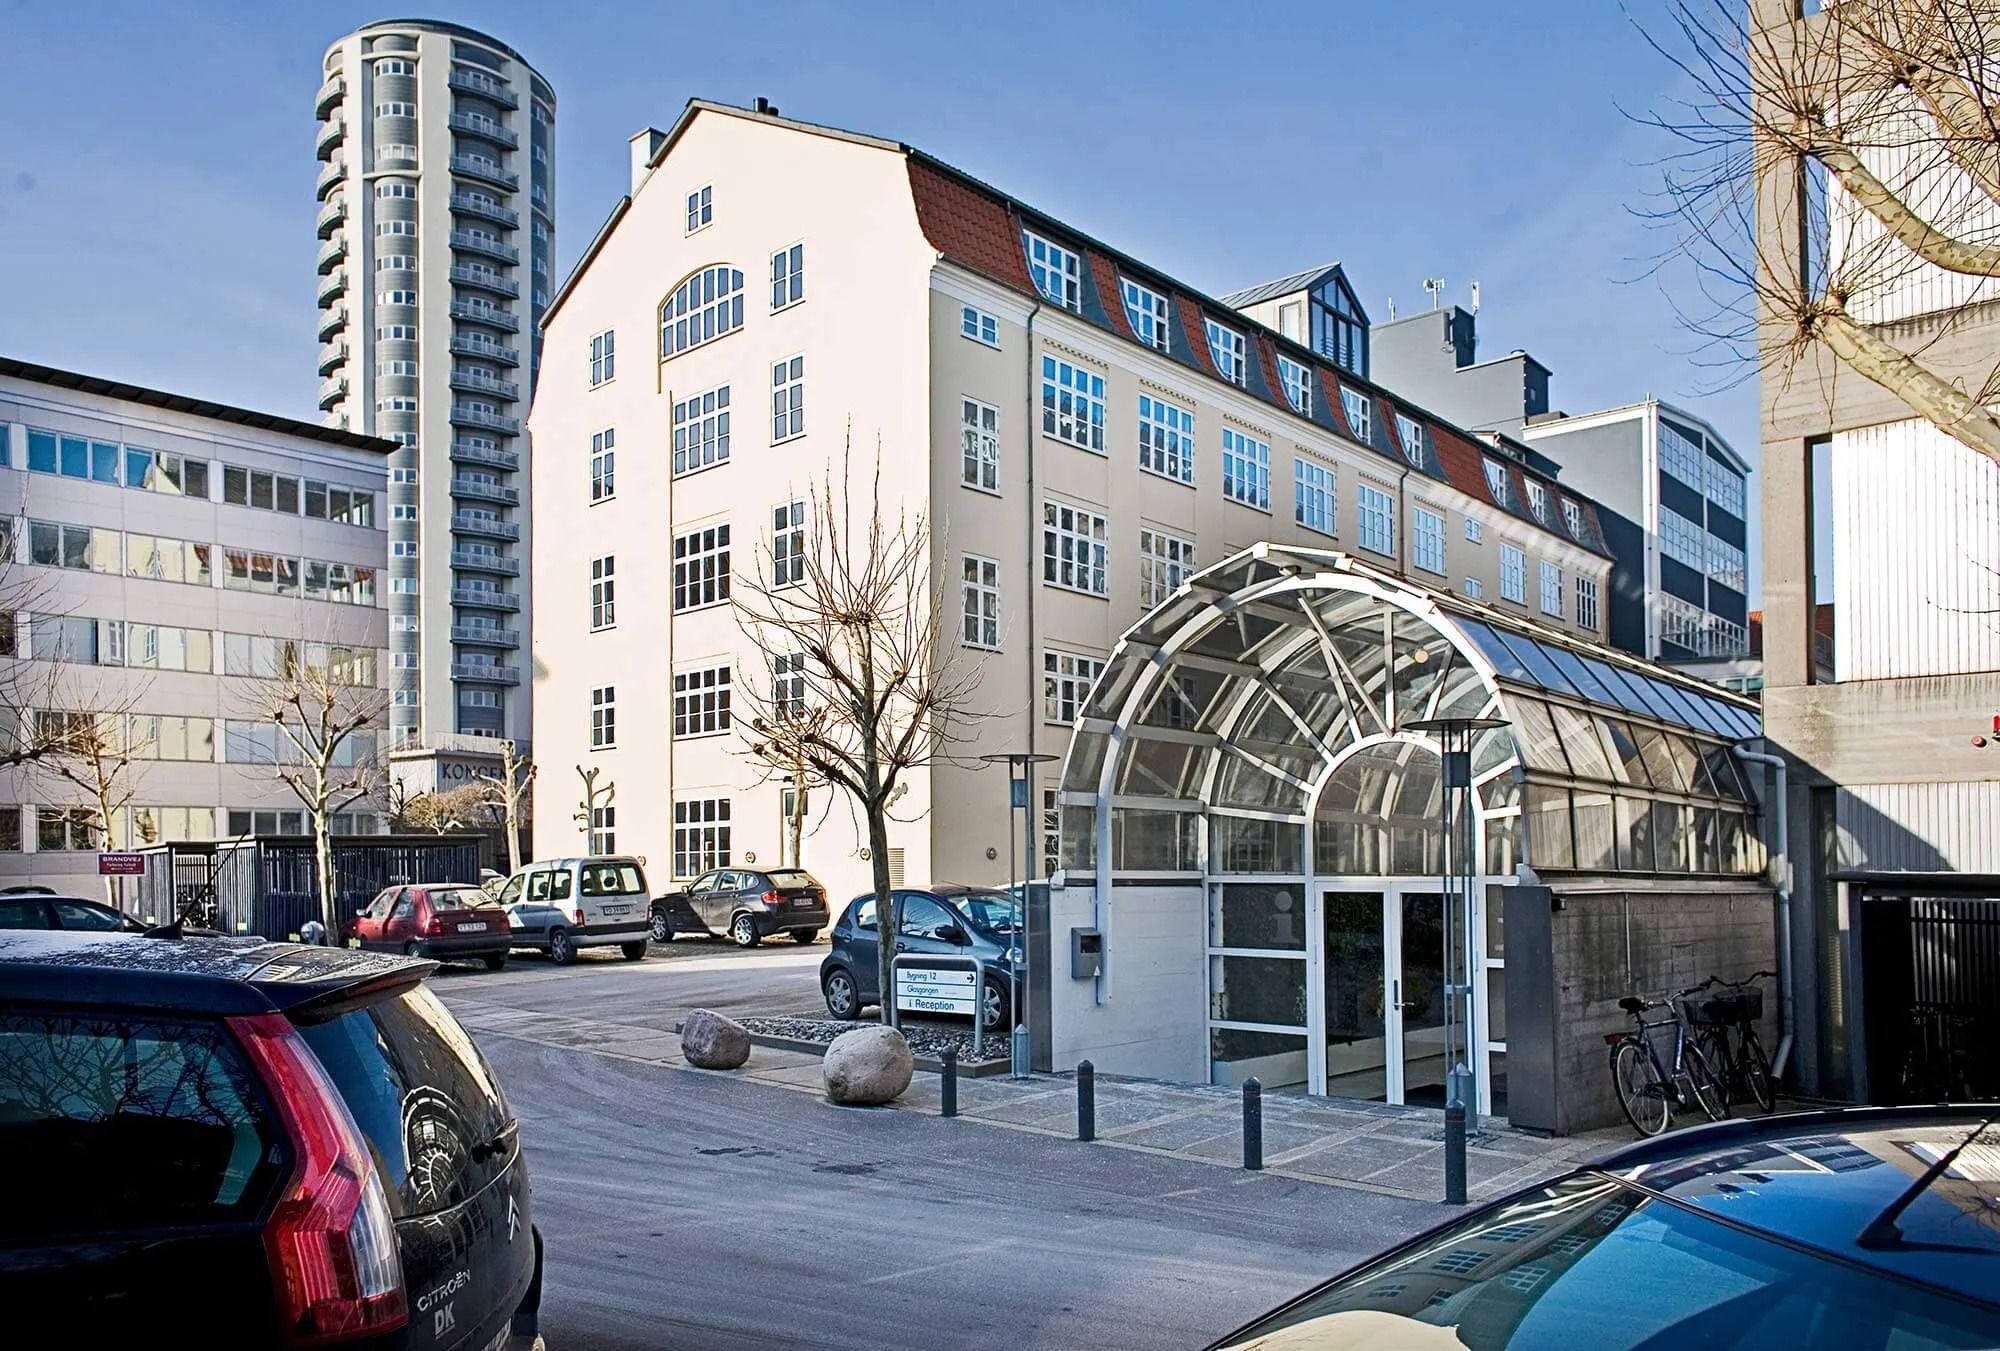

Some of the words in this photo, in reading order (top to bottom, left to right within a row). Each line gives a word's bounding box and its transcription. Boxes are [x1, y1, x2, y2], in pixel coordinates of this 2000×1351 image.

[929, 971, 937, 980] 12
[915, 999, 956, 1010] Reception
[434, 1300, 455, 1336] DK
